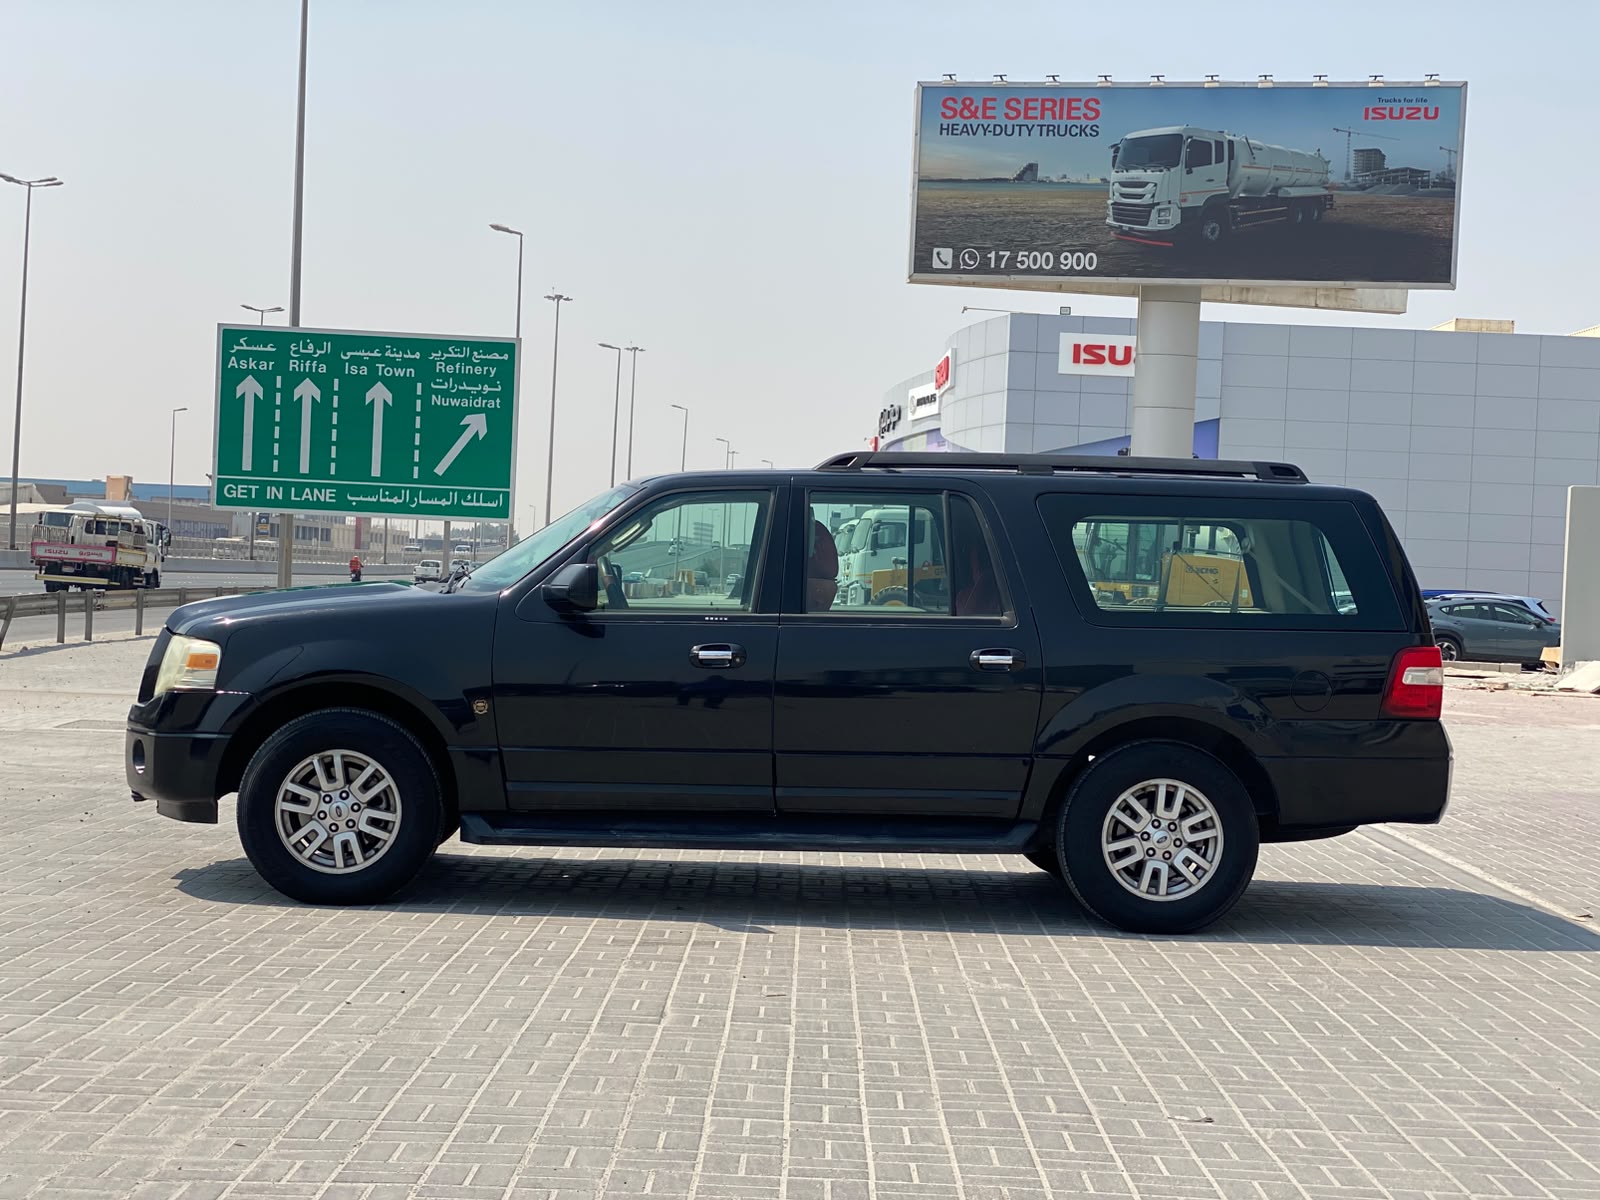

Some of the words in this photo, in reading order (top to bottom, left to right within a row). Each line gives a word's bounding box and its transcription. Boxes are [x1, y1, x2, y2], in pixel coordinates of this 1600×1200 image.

[940, 96, 998, 121] S&E
[1003, 97, 1101, 121] SERIES
[1363, 106, 1440, 121] ISUZU
[939, 123, 1037, 137] HEAVY-DUTY
[1037, 124, 1100, 137] TRUCKS
[987, 250, 1011, 269] 17
[1016, 251, 1054, 270] 500
[1059, 251, 1098, 271] 900
[229, 337, 277, 353] عسكر
[290, 339, 331, 357] الرفاع
[385, 345, 420, 361] مدينة
[428, 345, 470, 360] التكرير
[340, 348, 382, 360] عيسى
[472, 349, 509, 363] مصنع
[1072, 343, 1136, 366] ISU
[228, 356, 275, 371] Askar
[289, 359, 327, 373] Riffa
[345, 362, 368, 375] Isa
[375, 363, 415, 377] Town
[435, 361, 497, 378] Refinery
[430, 377, 502, 394] نويدرات
[431, 394, 501, 409] Nuwaidrat
[223, 483, 260, 499] GET
[266, 485, 283, 500] IN
[290, 486, 337, 502] LANE
[347, 488, 410, 506] المناسب
[409, 489, 459, 508] المسار
[461, 491, 503, 507] اسلك
